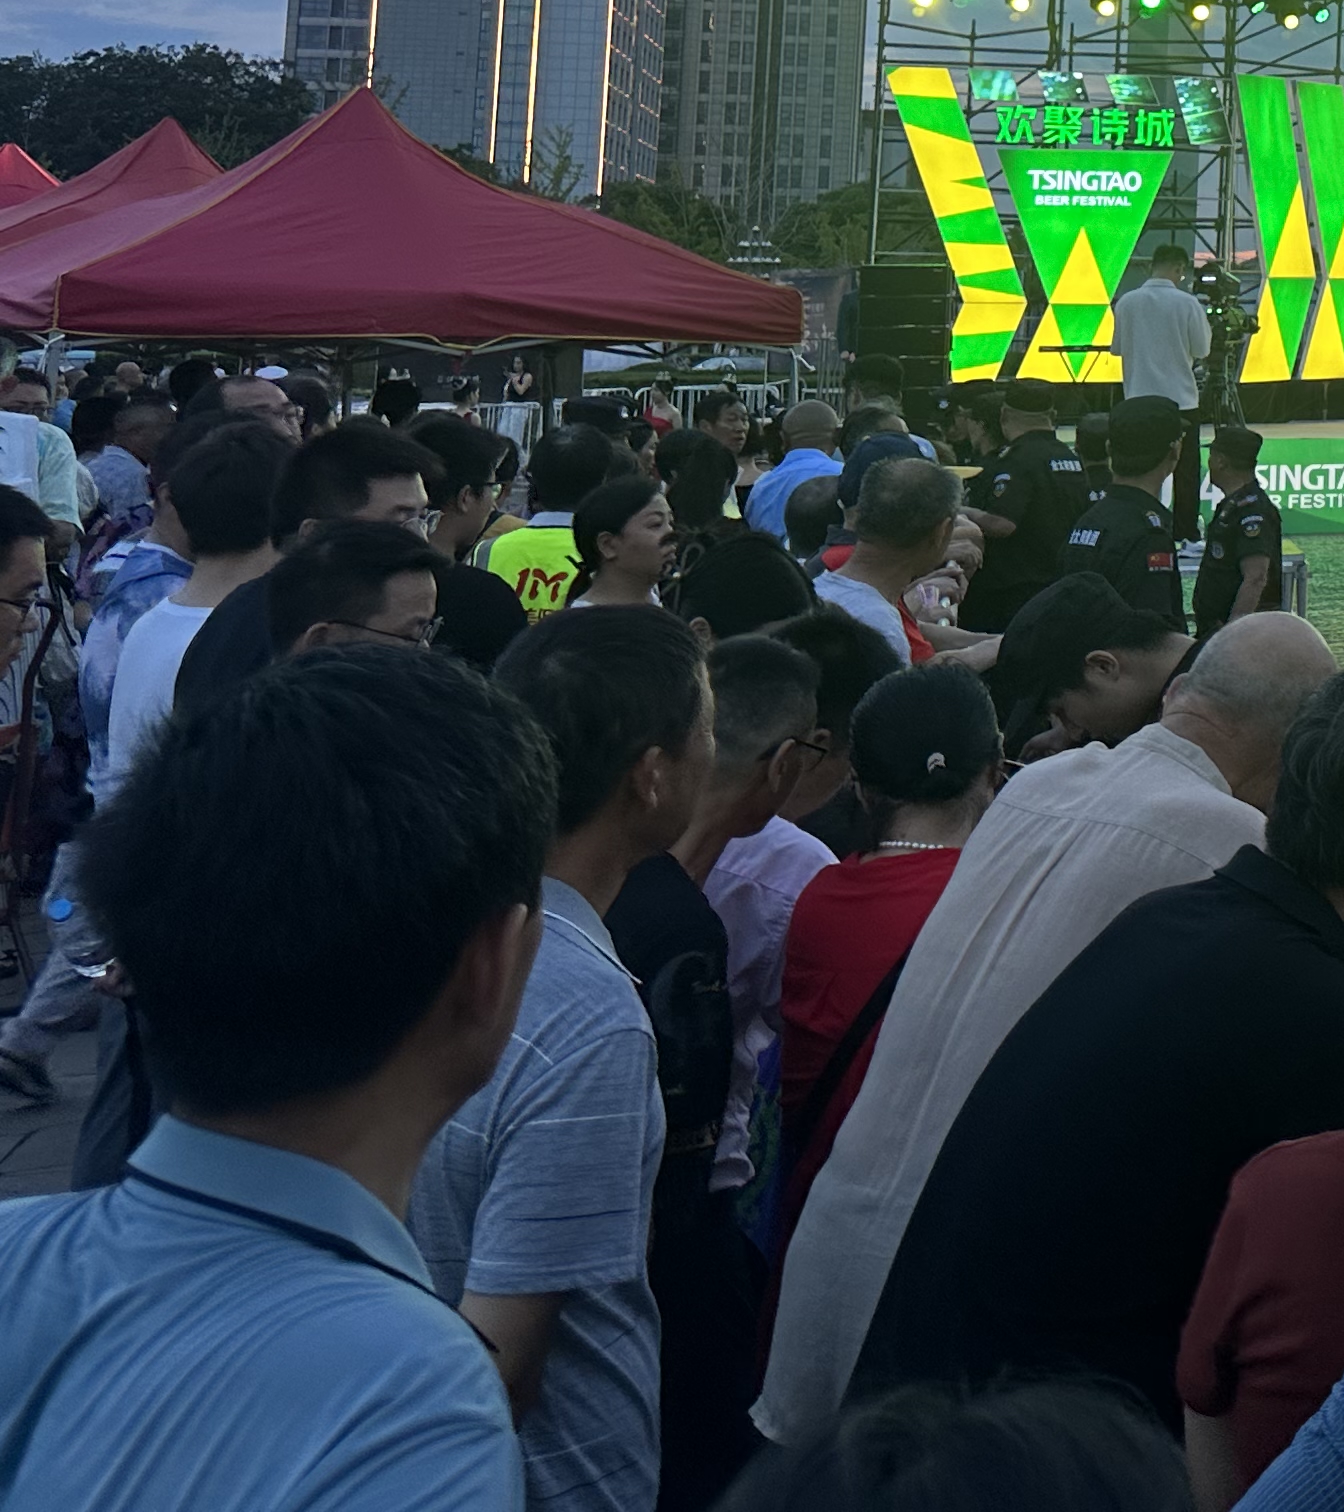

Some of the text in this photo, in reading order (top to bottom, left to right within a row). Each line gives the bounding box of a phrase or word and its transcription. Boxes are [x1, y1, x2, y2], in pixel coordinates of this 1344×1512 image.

[995, 104, 1176, 148] 欢聚诗城
[1027, 169, 1143, 192] TSINGTAO
[1035, 195, 1132, 207] BEER FESTIVAL
